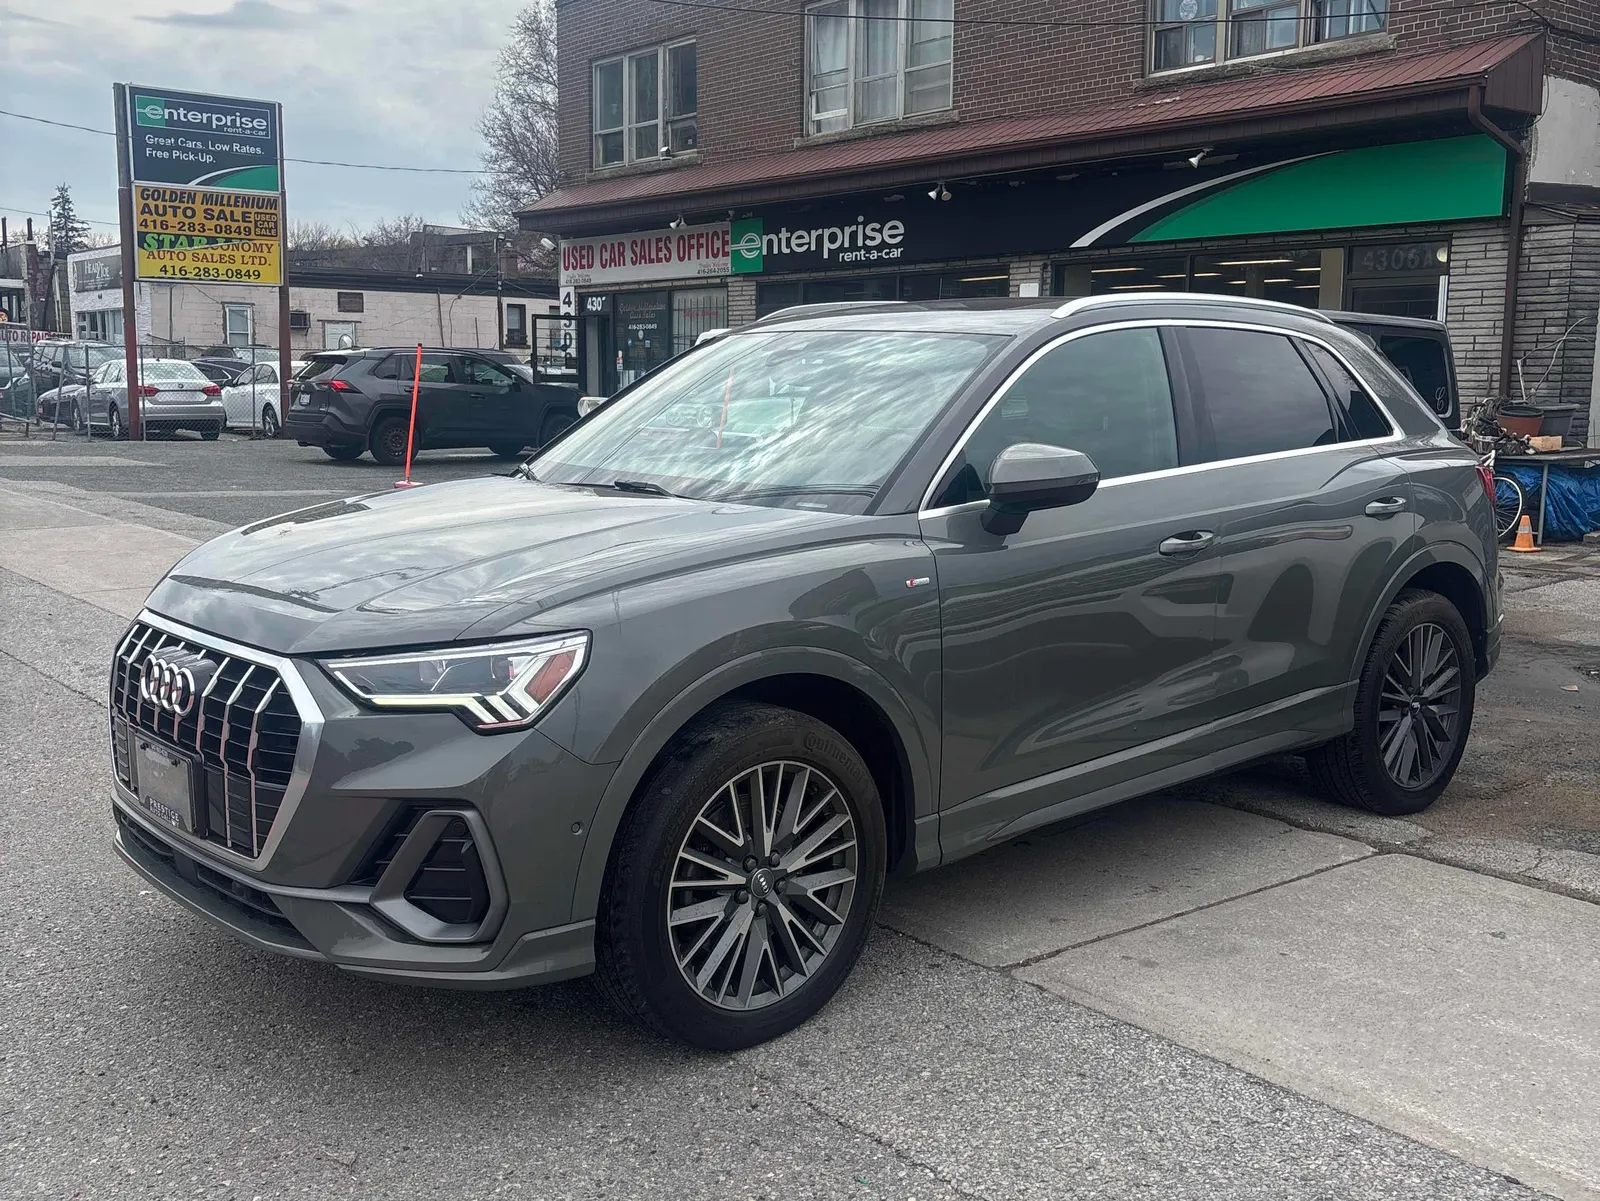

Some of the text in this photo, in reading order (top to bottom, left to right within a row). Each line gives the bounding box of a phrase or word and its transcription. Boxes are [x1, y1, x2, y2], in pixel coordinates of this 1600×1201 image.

[137, 105, 267, 129] enterprise
[223, 127, 267, 136] rent-a-car
[145, 135, 264, 155] Great Cars. Low Rates.
[146, 148, 216, 164] Free Pick-Up.
[140, 188, 278, 210] GOLDEN MILLENIUM
[140, 203, 252, 223] AUTO SALE
[255, 213, 277, 222] USED
[140, 219, 252, 236] 416-283-0849
[255, 228, 277, 236] SALE
[731, 215, 905, 259] enterprise
[146, 250, 271, 266] AUTO SALES LTD.
[563, 229, 730, 272] USED CAR SALES OFFICE
[838, 247, 904, 262] rent-a-car
[160, 265, 261, 280] 416-283-0849
